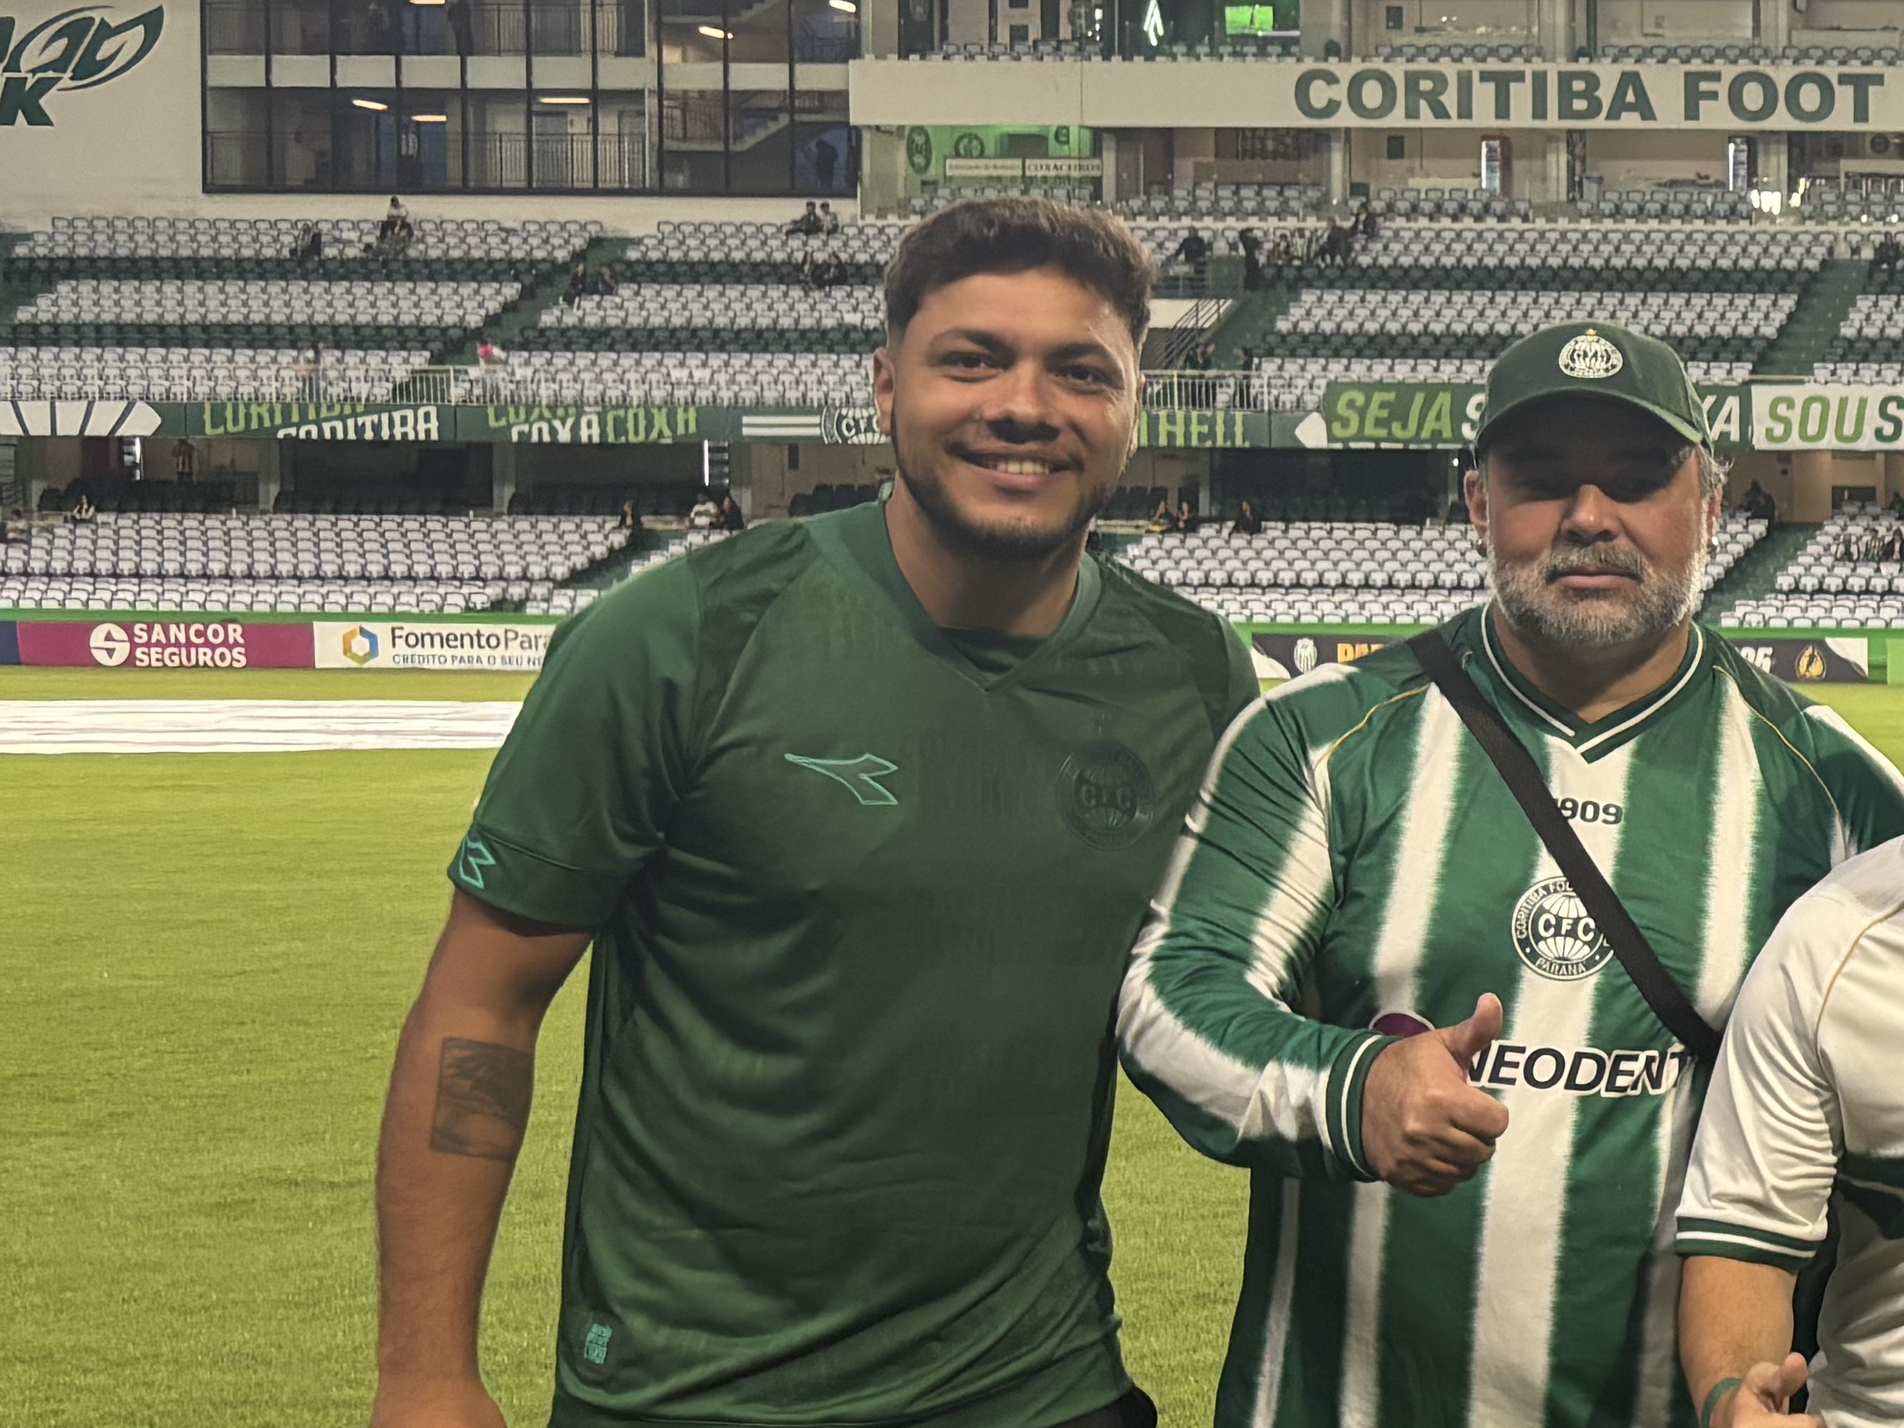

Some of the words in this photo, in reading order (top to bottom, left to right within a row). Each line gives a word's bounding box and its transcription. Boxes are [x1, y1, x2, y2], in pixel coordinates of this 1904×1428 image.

[1293, 67, 1657, 123] CORITIBA
[1682, 70, 1884, 125] FOOT
[1331, 390, 1452, 440] SEJA
[1765, 396, 1868, 445] SOU
[134, 623, 244, 644] SANCOR
[135, 647, 247, 668] SEGUROS
[1554, 797, 1624, 825] 909
[1538, 913, 1595, 942] CFC
